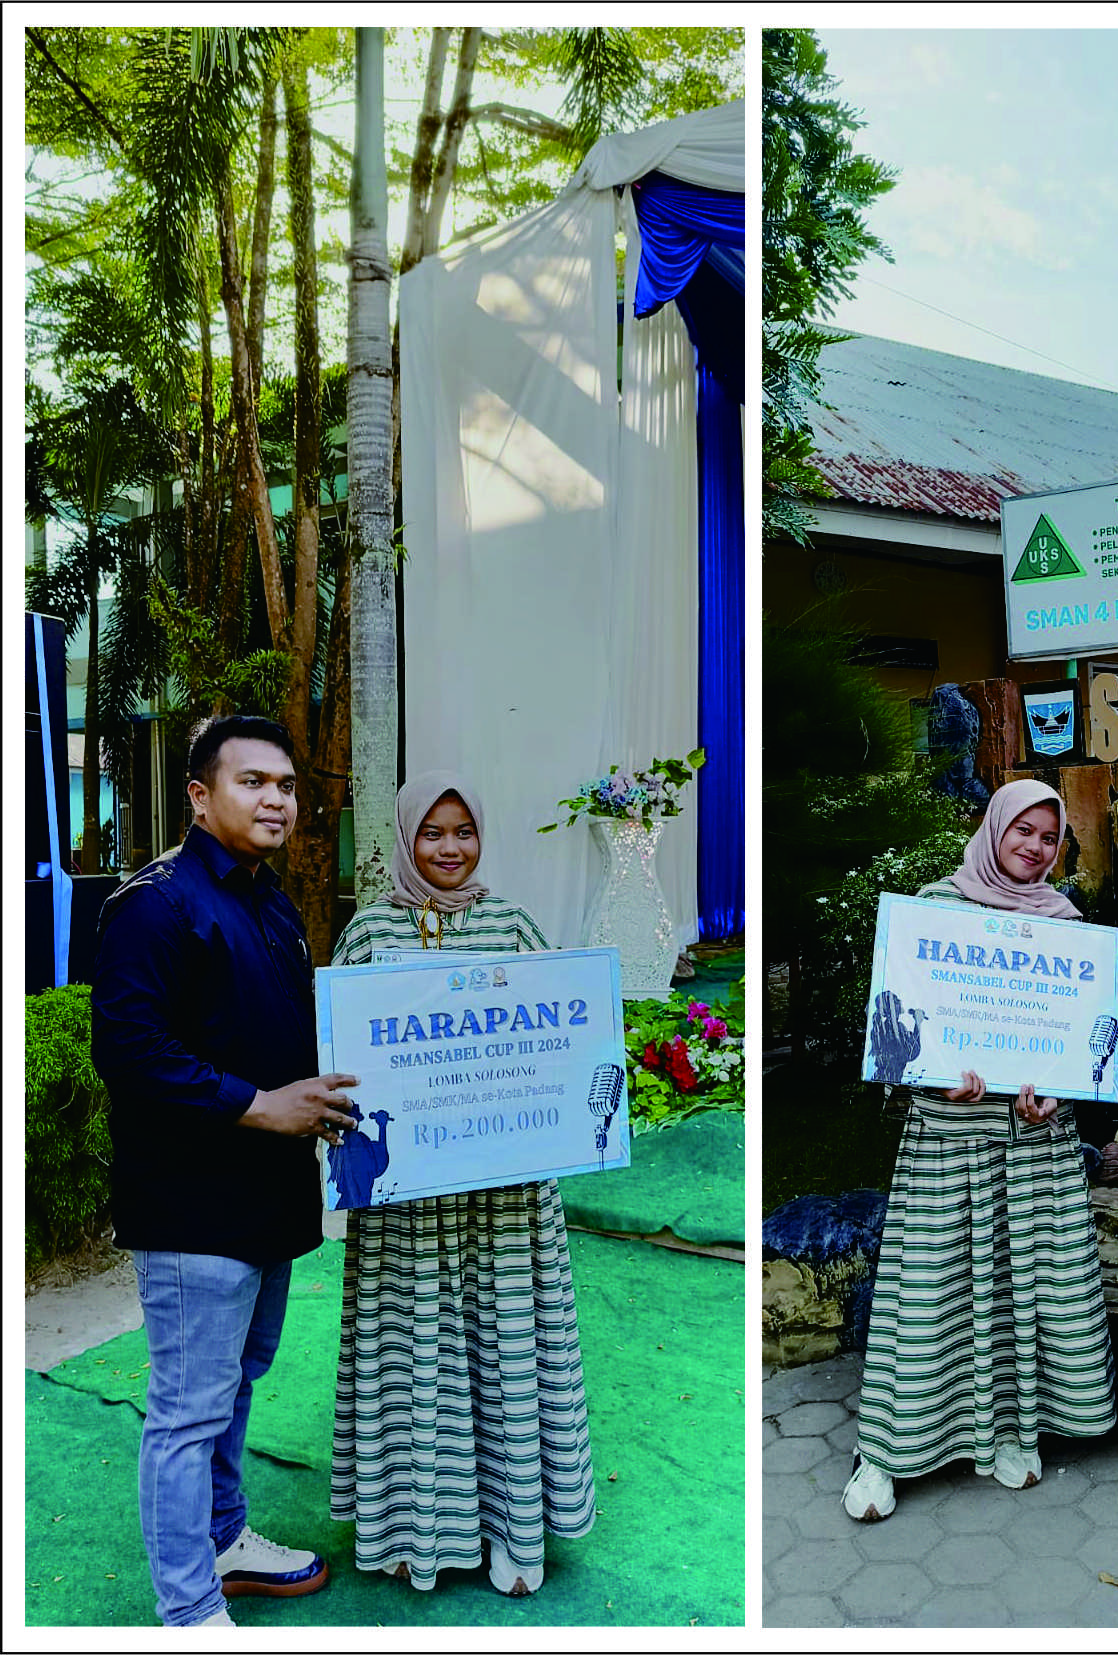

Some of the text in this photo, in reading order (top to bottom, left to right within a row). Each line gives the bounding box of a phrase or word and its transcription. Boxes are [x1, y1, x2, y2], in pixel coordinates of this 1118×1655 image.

[1025, 604, 1089, 631] SMAN
[1095, 601, 1109, 622] 4
[916, 938, 1095, 981] HARAPAN 2
[930, 969, 1079, 998] SMANSABEL CUP III 2024
[960, 992, 1048, 1011] LOMBA SOLOSONG
[369, 999, 588, 1047] HARAPAN 2
[390, 1037, 571, 1069] SMANSABEL CUP III 2024
[943, 1026, 1064, 1055] Rp.200.000
[428, 1064, 537, 1088] LOMBA SOLOSONG
[524, 1083, 565, 1097] Padang
[414, 1107, 560, 1149] Rp.200.000
